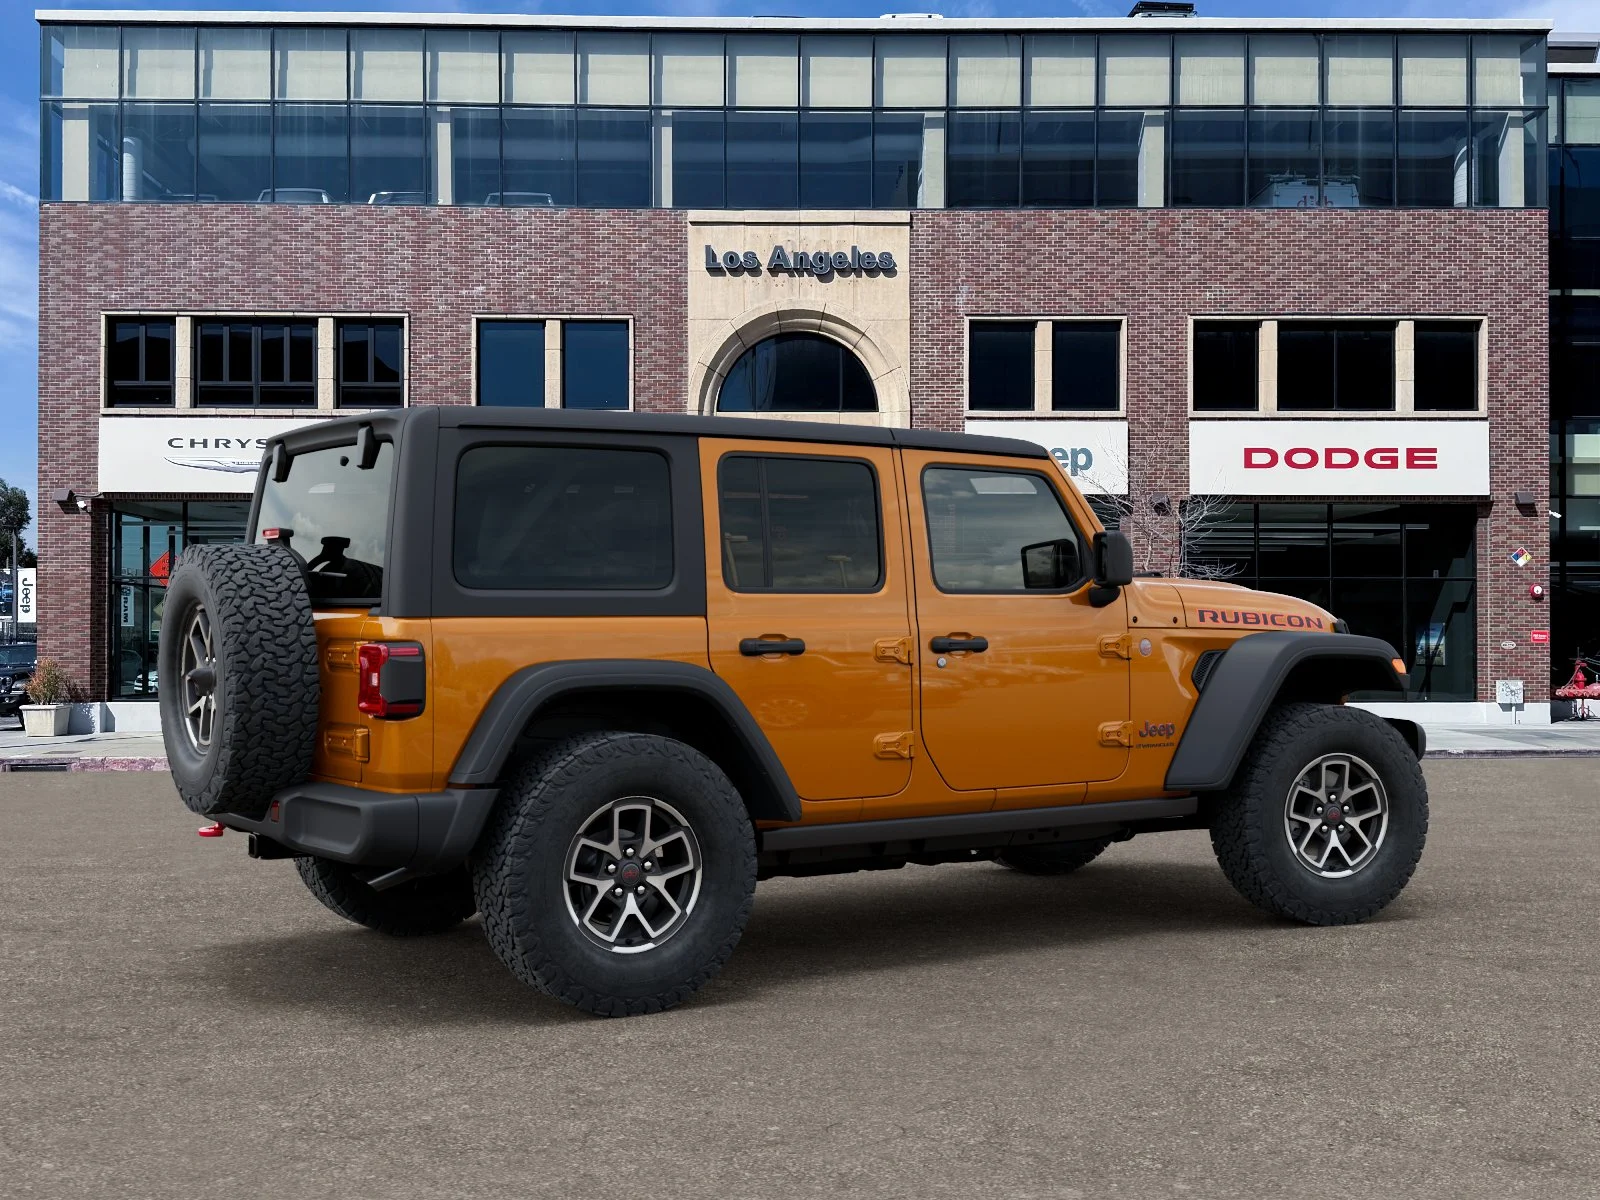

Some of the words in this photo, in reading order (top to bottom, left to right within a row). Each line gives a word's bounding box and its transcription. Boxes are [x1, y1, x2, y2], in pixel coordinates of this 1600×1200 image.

[704, 244, 760, 269] Los
[767, 244, 895, 275] Angeles
[167, 437, 268, 449] CHRYS
[1049, 447, 1093, 477] ep
[1243, 447, 1438, 470] DODGE
[20, 577, 34, 614] Jeep
[1197, 608, 1324, 630] RUBICON
[1138, 719, 1176, 739] Jeep
